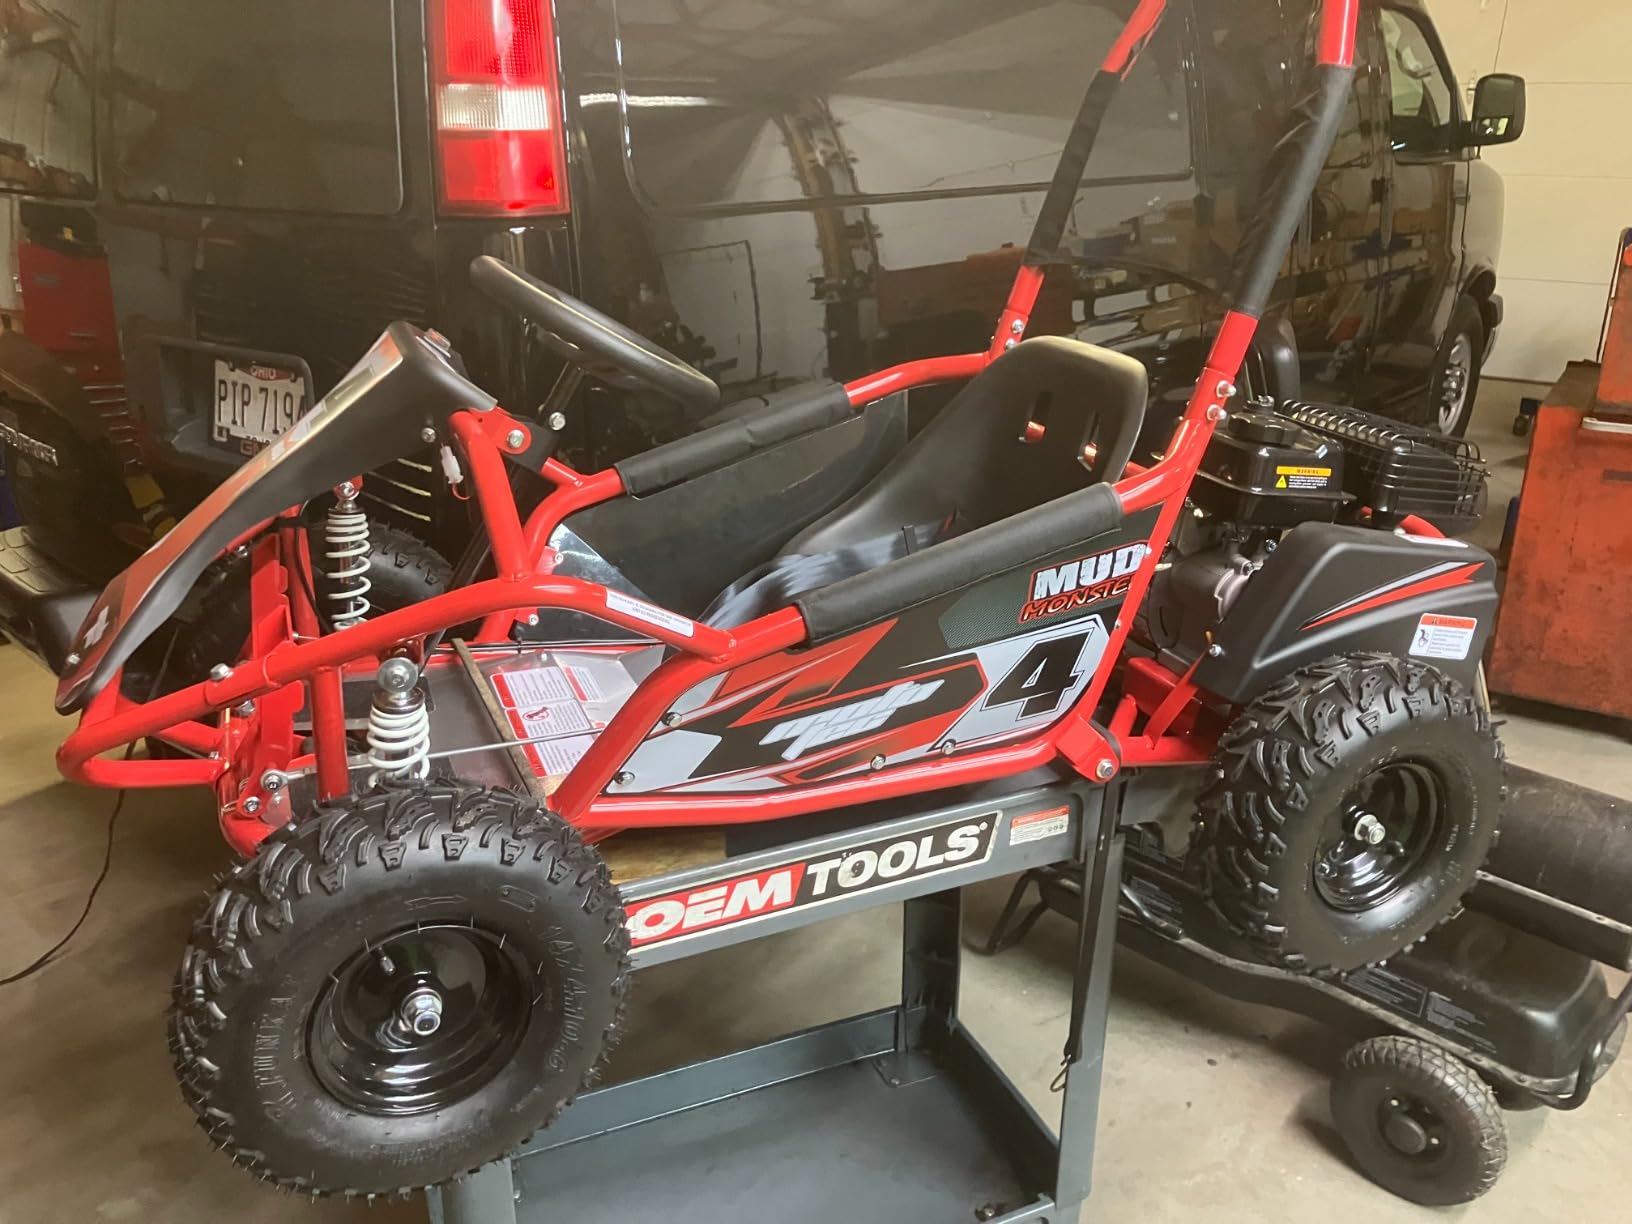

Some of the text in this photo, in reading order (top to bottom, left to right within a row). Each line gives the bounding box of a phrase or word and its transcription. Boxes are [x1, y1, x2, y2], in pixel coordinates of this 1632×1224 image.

[250, 365, 277, 380] OHIO
[218, 379, 252, 428] PIP
[1034, 543, 1149, 600] MUD
[1022, 576, 1132, 621] MONSTE
[981, 627, 1094, 721] 4
[625, 872, 792, 940] OEM
[806, 824, 981, 895] TOOLS
